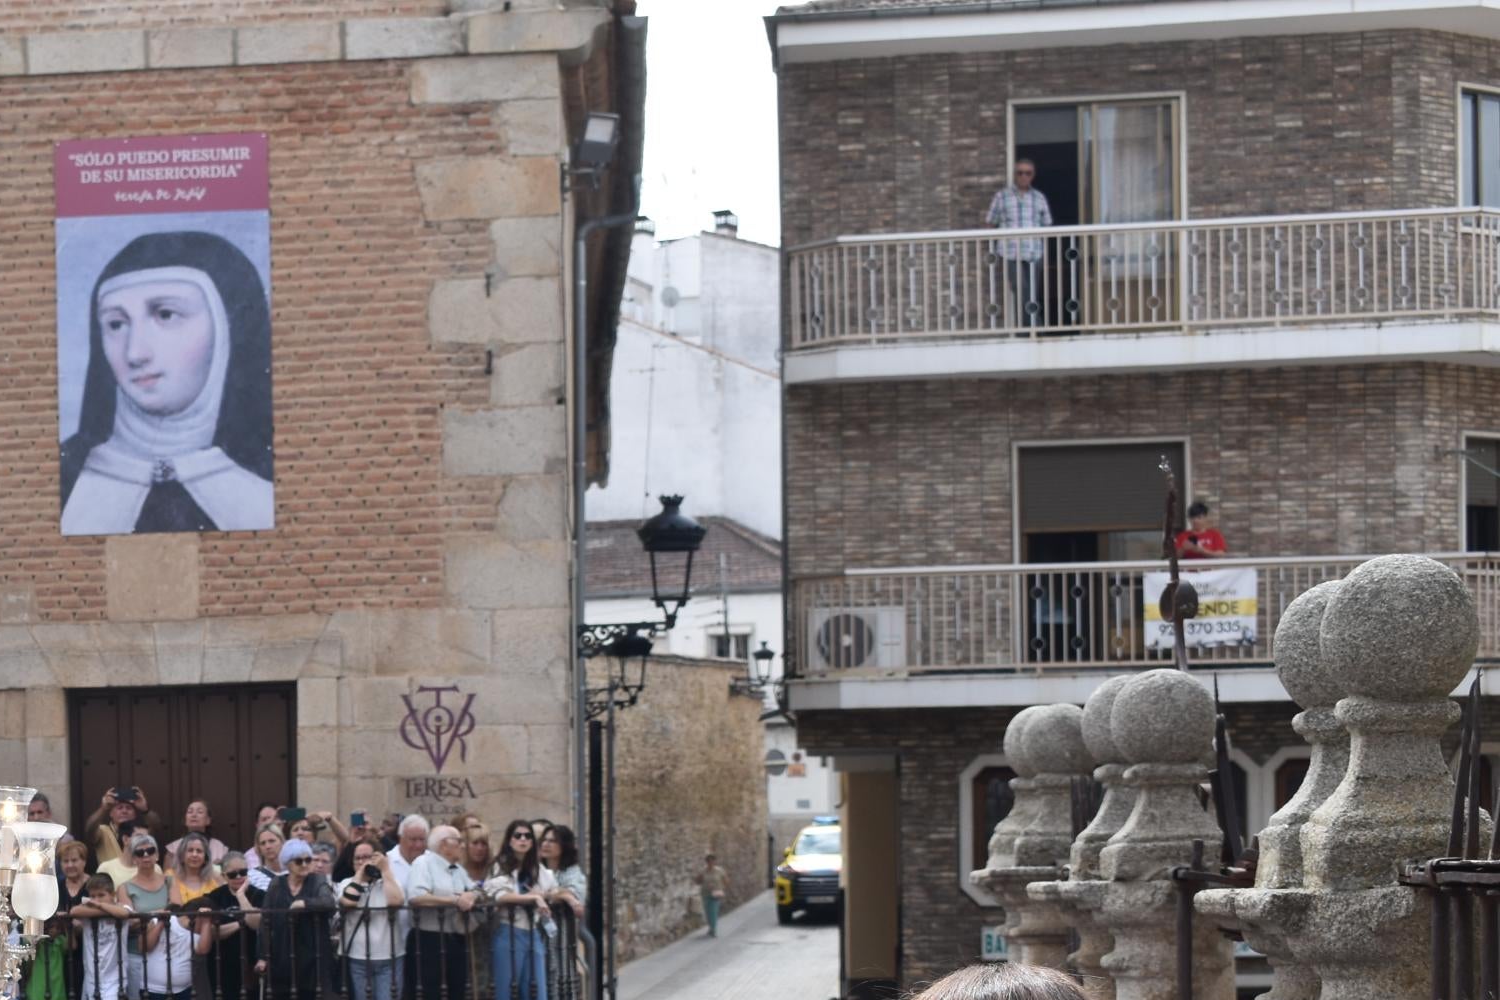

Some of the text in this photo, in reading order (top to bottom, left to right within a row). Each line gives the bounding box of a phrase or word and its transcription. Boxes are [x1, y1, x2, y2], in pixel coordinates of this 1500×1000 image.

[118, 149, 168, 165] PUEDO
[172, 147, 250, 163] PRESUMIR
[80, 169, 101, 184] DE
[104, 168, 124, 182] SU
[1197, 601, 1239, 616] ENDE
[1187, 622, 1213, 635] 370
[1216, 620, 1241, 633] 335
[985, 933, 1007, 954] BA
